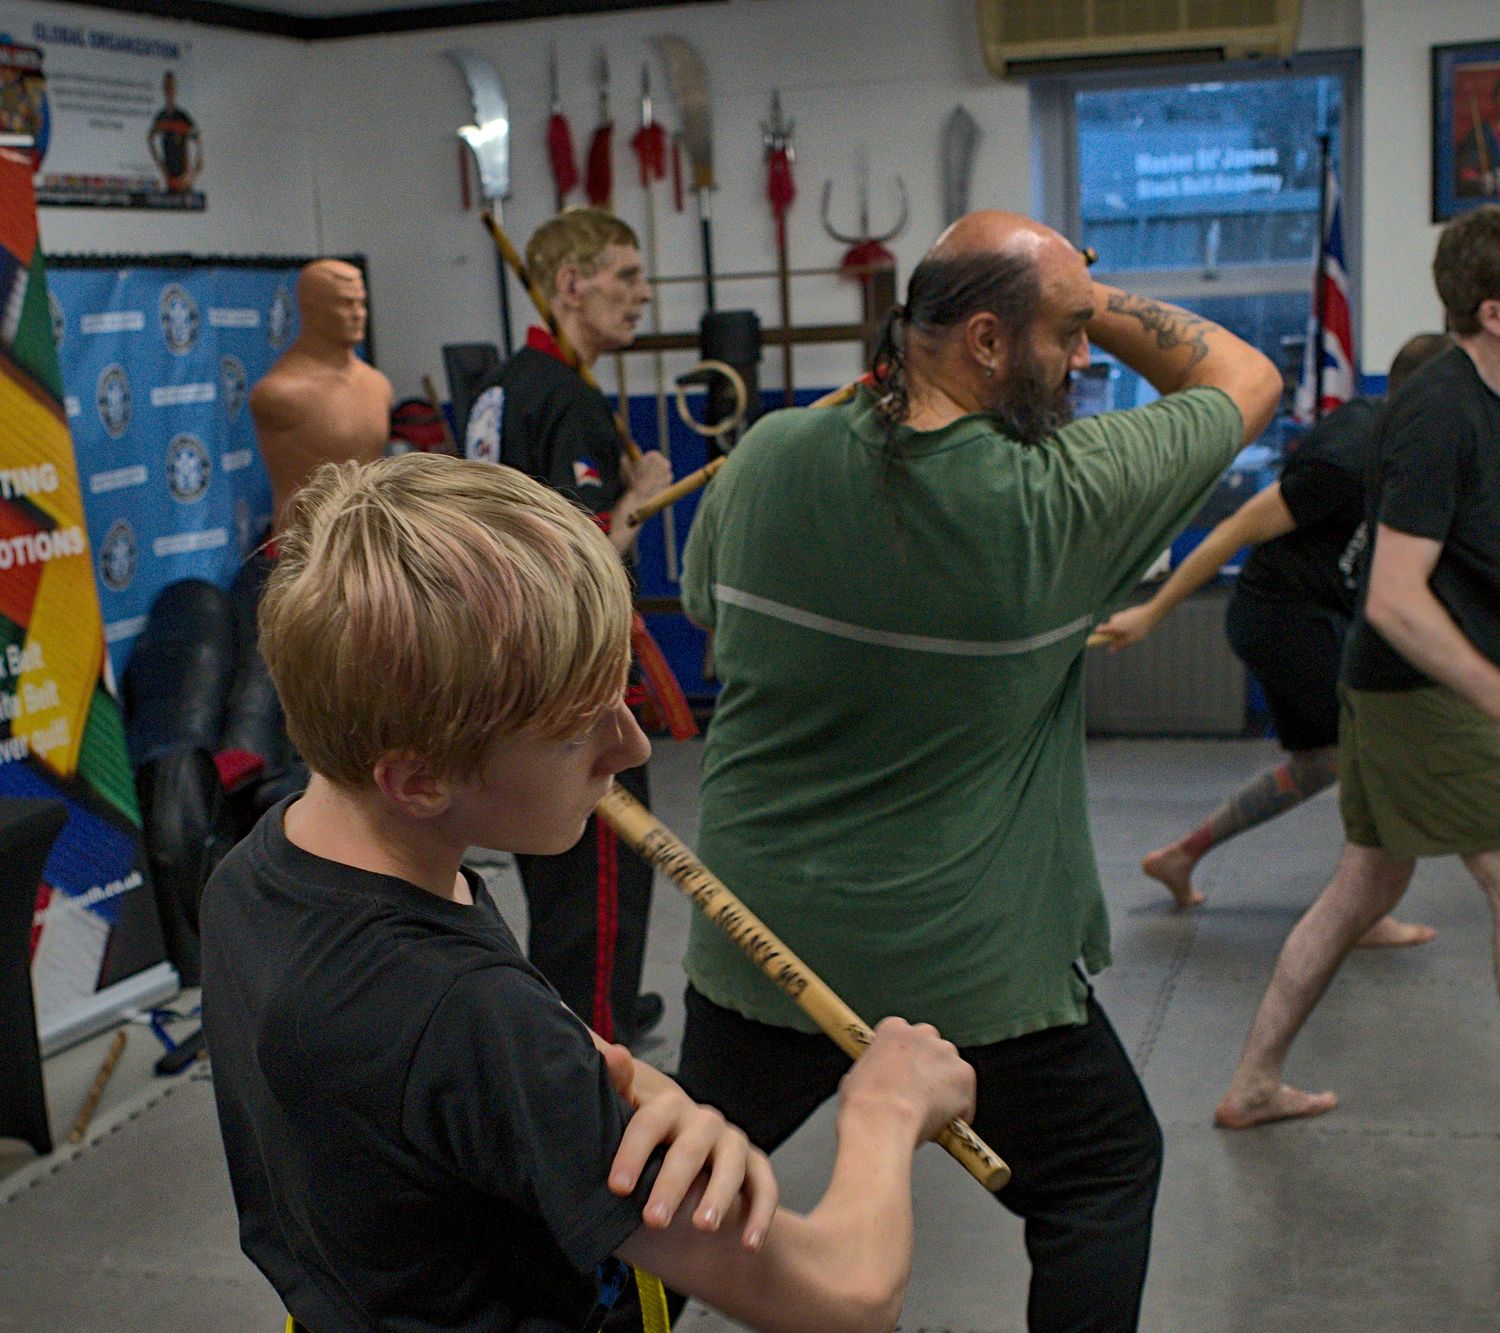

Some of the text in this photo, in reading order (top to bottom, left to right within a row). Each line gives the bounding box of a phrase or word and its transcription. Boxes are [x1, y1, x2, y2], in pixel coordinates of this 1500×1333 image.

[1222, 148, 1279, 169] James
[6, 640, 46, 677] Belt
[23, 677, 61, 714] Belt
